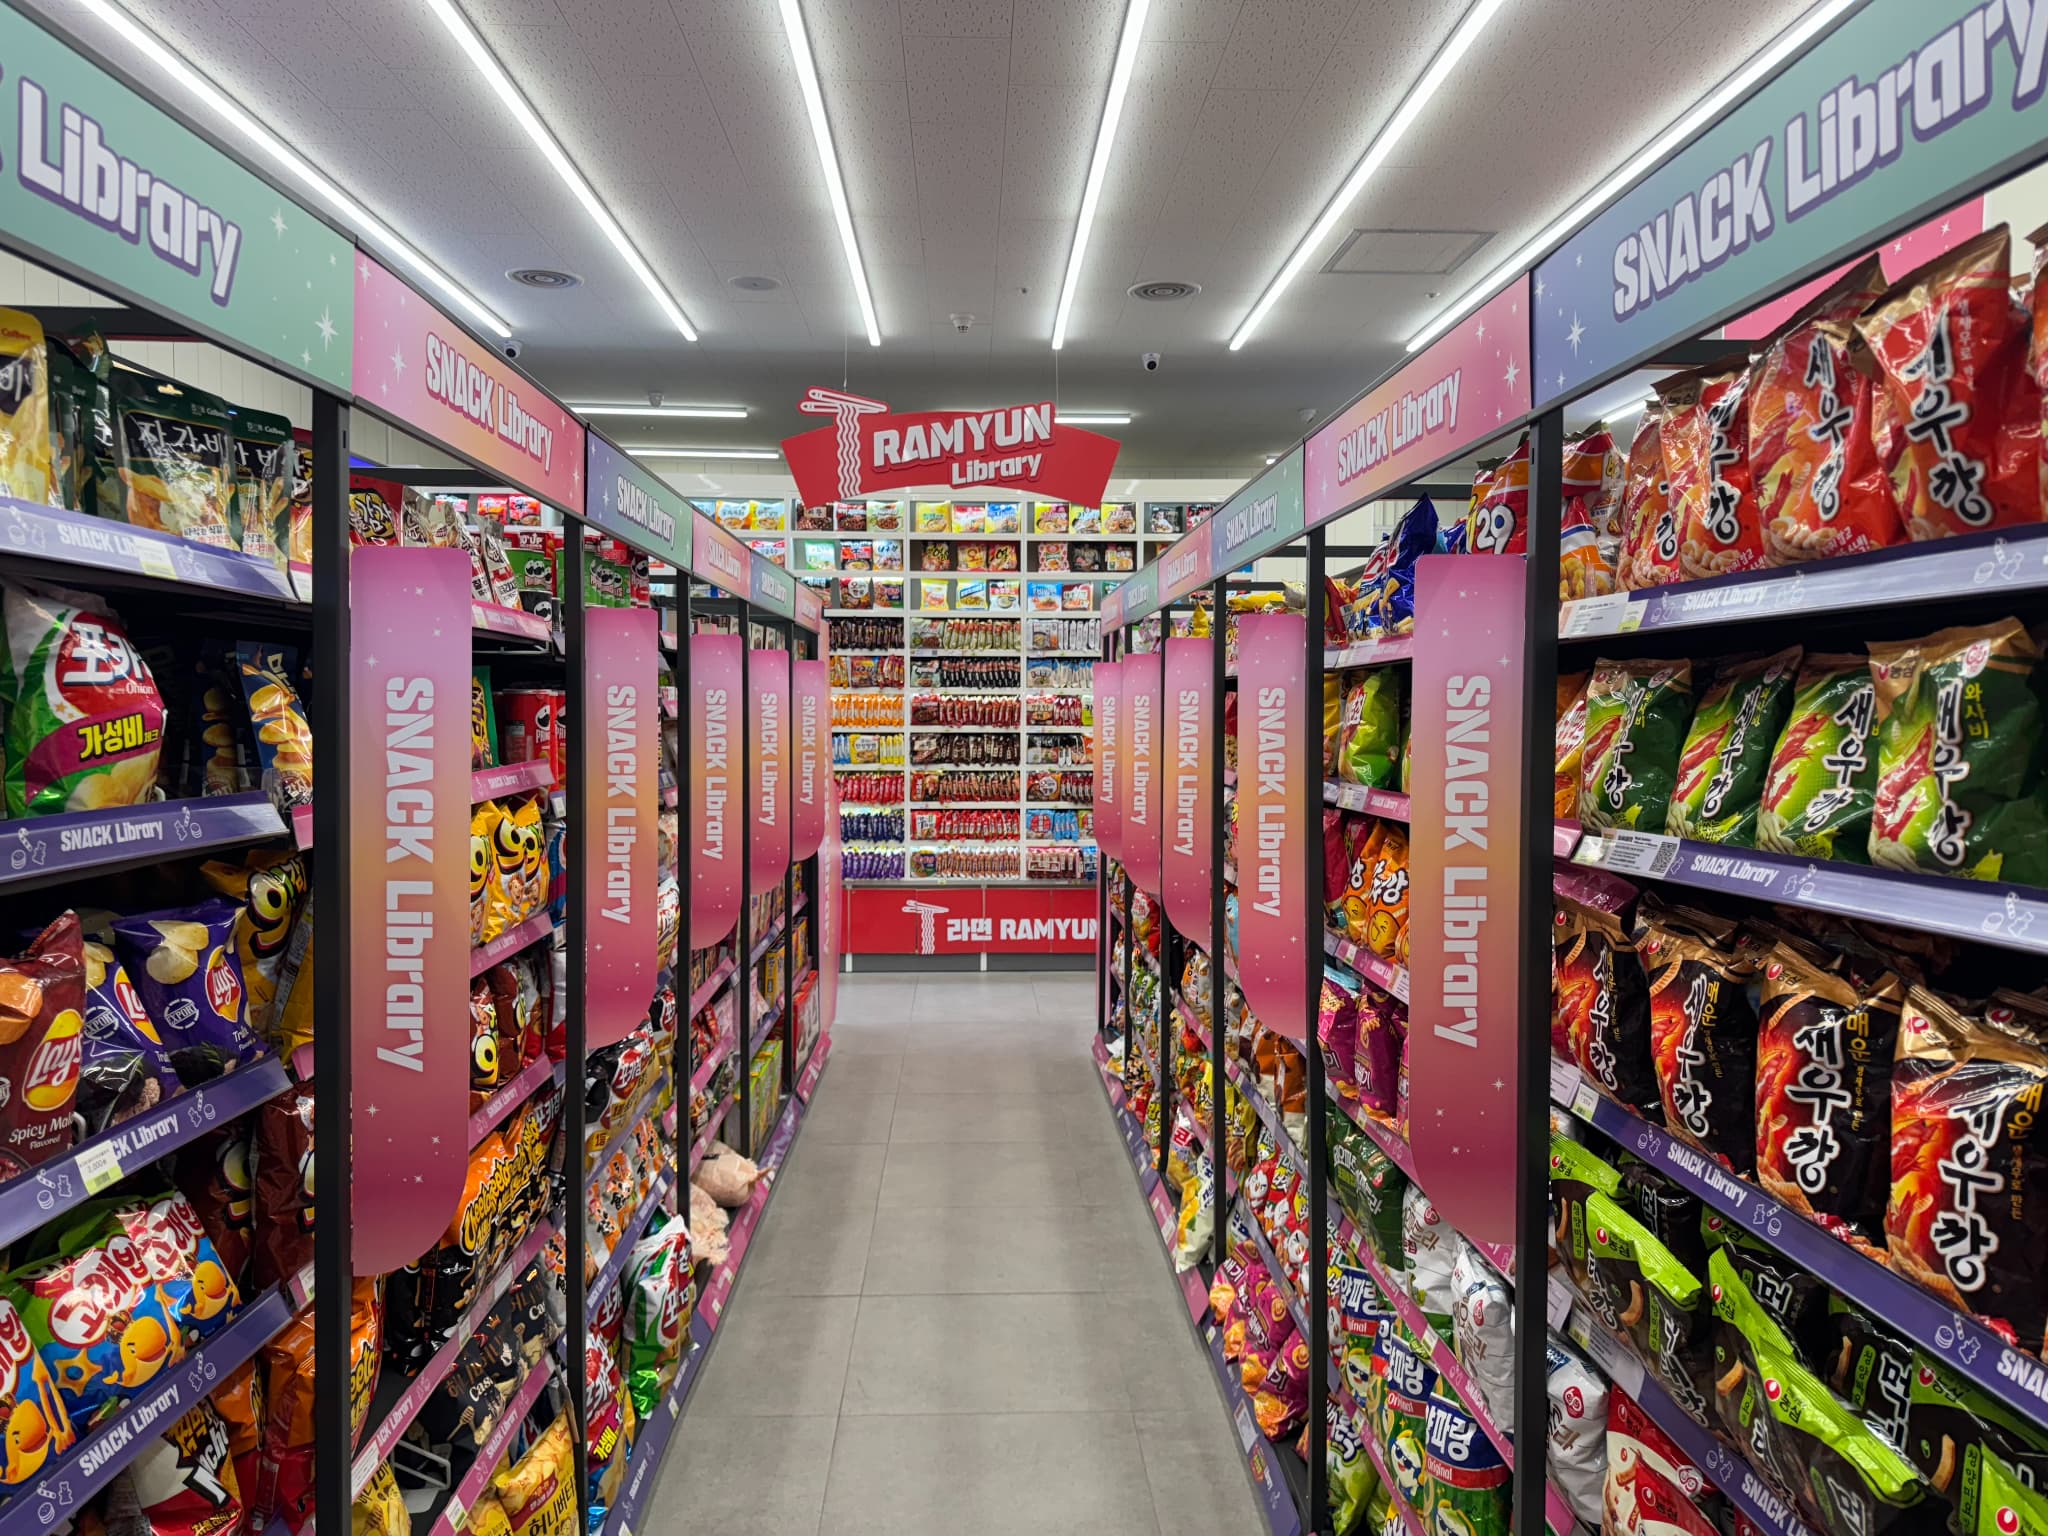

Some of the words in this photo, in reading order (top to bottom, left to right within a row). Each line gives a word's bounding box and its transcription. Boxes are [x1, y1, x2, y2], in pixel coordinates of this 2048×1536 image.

[19, 77, 240, 306] Library
[1614, 136, 1773, 320] SNACK
[1787, 0, 2048, 220] Library
[427, 333, 495, 430] SNACK
[498, 385, 553, 473] Library
[1337, 407, 1389, 486] SNACK
[1391, 369, 1462, 454] Library
[873, 404, 1051, 468] RAMYUN
[951, 453, 1042, 486] Library
[58, 524, 113, 552] SNACK
[617, 474, 648, 529] SNACK
[649, 496, 676, 550] Library
[1225, 505, 1248, 551] SNACK
[1249, 492, 1278, 542] Library
[1682, 591, 1721, 613] SNACK
[1722, 586, 1768, 607] Library
[63, 621, 153, 685] 포카
[126, 683, 153, 695] Onion
[801, 695, 816, 746] SNACK
[1964, 683, 1990, 739] 와사비
[78, 714, 145, 760] 가성비
[606, 685, 636, 798] SNACK
[705, 688, 727, 770] SNACK
[760, 692, 777, 755] SNACK
[1102, 696, 1116, 747] SNACK
[1133, 695, 1151, 756] SNACK
[1177, 690, 1200, 769] SNACK
[1258, 687, 1286, 796] SNACK
[386, 675, 434, 864] SNACK
[799, 752, 816, 805] Library
[1099, 751, 1115, 804] Library
[1444, 675, 1490, 851] SNACK
[1804, 684, 1875, 831] 새우깡
[702, 778, 728, 860] Library
[758, 760, 777, 827] Library
[1130, 761, 1150, 825] Library
[1173, 775, 1199, 856] Library
[60, 827, 113, 852] SNACK
[116, 820, 163, 844] Library
[601, 807, 636, 925] Library
[1253, 805, 1286, 918] Library
[1690, 854, 1732, 876] SNACK
[1731, 858, 1778, 887] Library
[947, 918, 992, 942] 라면
[1000, 918, 1097, 941] RAMYUN
[1434, 866, 1488, 1048] Library
[376, 880, 434, 1072] Library
[1702, 981, 1720, 1027] 매운
[165, 1002, 200, 1027] EXPORT
[1846, 1012, 1872, 1063] 매운
[1673, 973, 1713, 1137] 새우깡
[9, 1125, 47, 1144] Spicy
[134, 1112, 180, 1150] Library
[1783, 1012, 1852, 1194] 새우깡
[30, 1135, 61, 1150] Flavored
[1668, 1142, 1706, 1179] SNACK
[1704, 1164, 1748, 1208] Library
[79, 1422, 134, 1477] SNACK
[131, 1384, 180, 1433] Library
[389, 1395, 413, 1429] Library
[486, 1434, 503, 1459] SNACK
[500, 1409, 518, 1436] Library
[593, 1427, 617, 1461] 가성비
[1427, 1457, 1453, 1481] Original
[1741, 1472, 1788, 1529] SNACK
